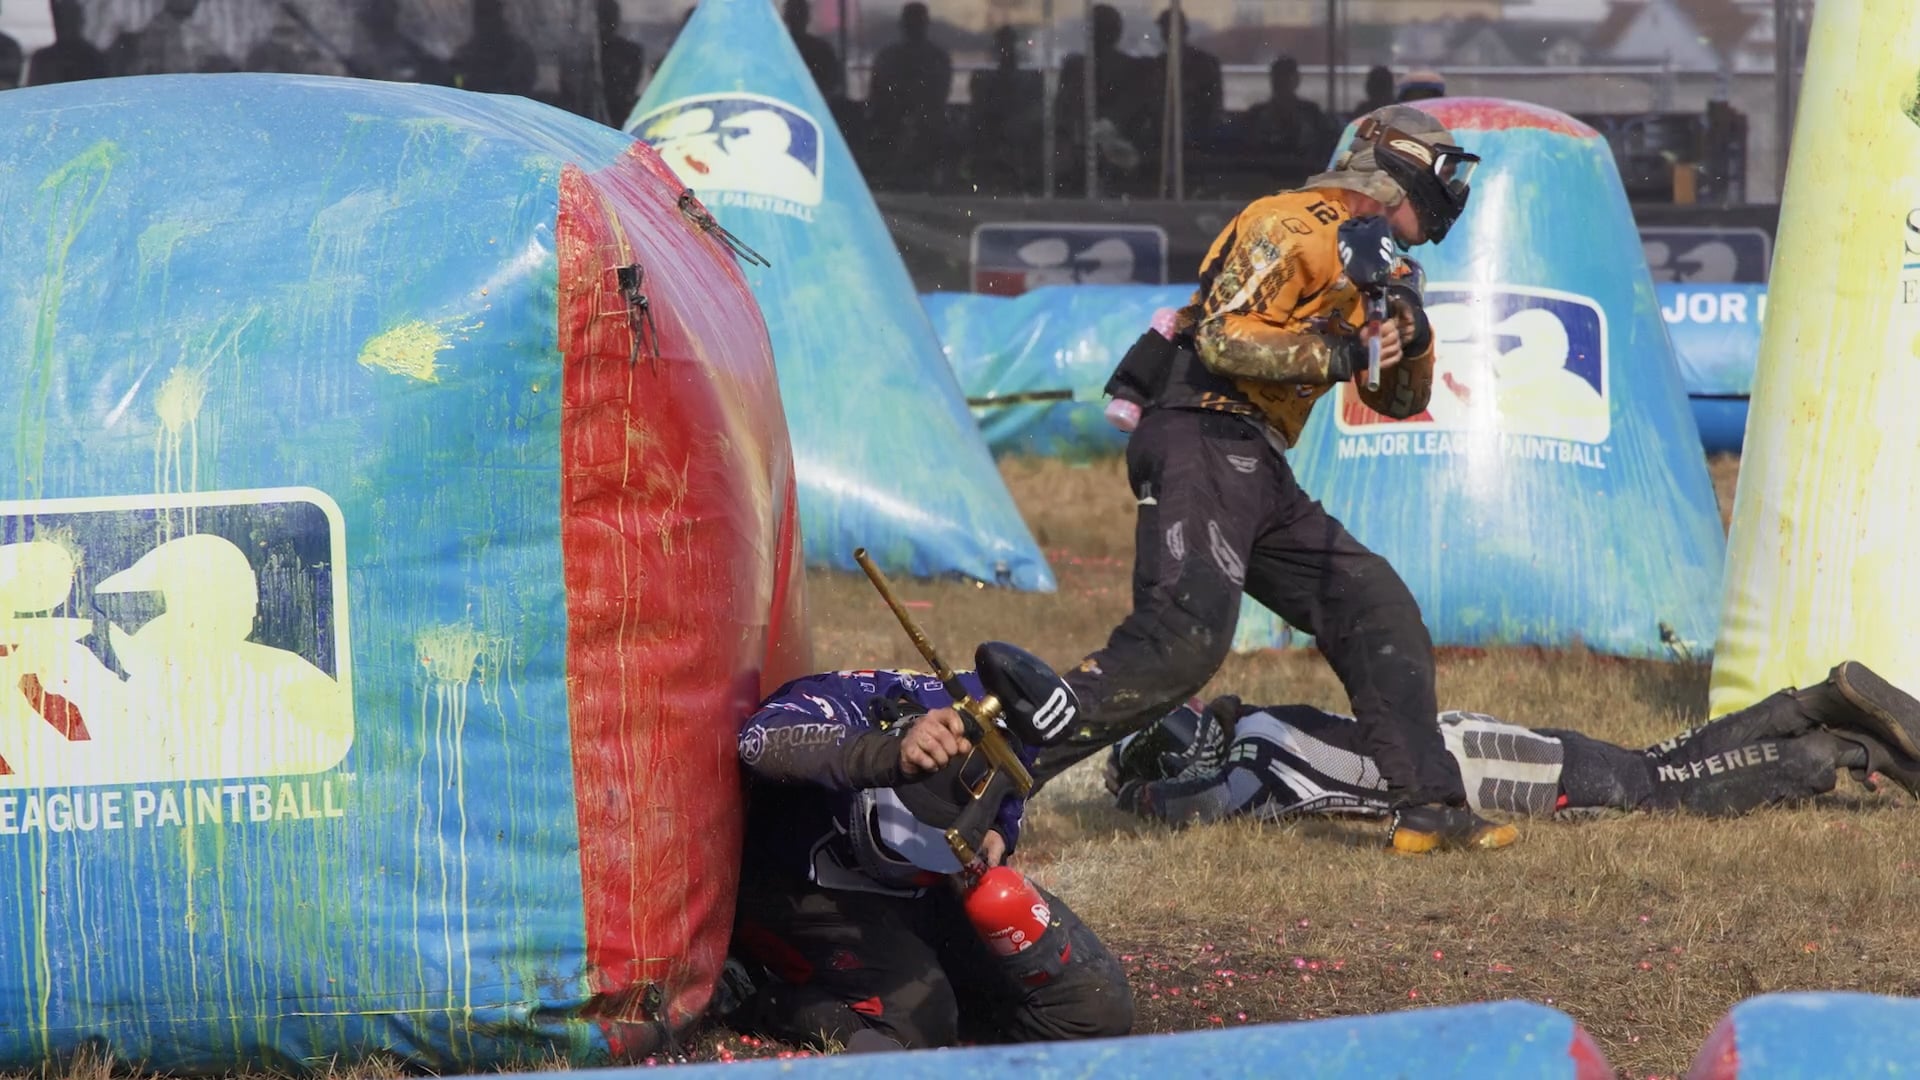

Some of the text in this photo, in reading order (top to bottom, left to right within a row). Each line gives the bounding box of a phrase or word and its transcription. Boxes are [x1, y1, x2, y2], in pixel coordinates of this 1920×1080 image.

[722, 191, 816, 224] PAINTBALL
[1304, 200, 1340, 226] 12
[1662, 292, 1748, 324] JOR
[1338, 432, 1606, 469] MAJOR LEAG PAINTBALL
[1657, 742, 1780, 783] REFEREE
[0, 790, 125, 836] EAGUE
[133, 779, 344, 829] PAINTBALL
